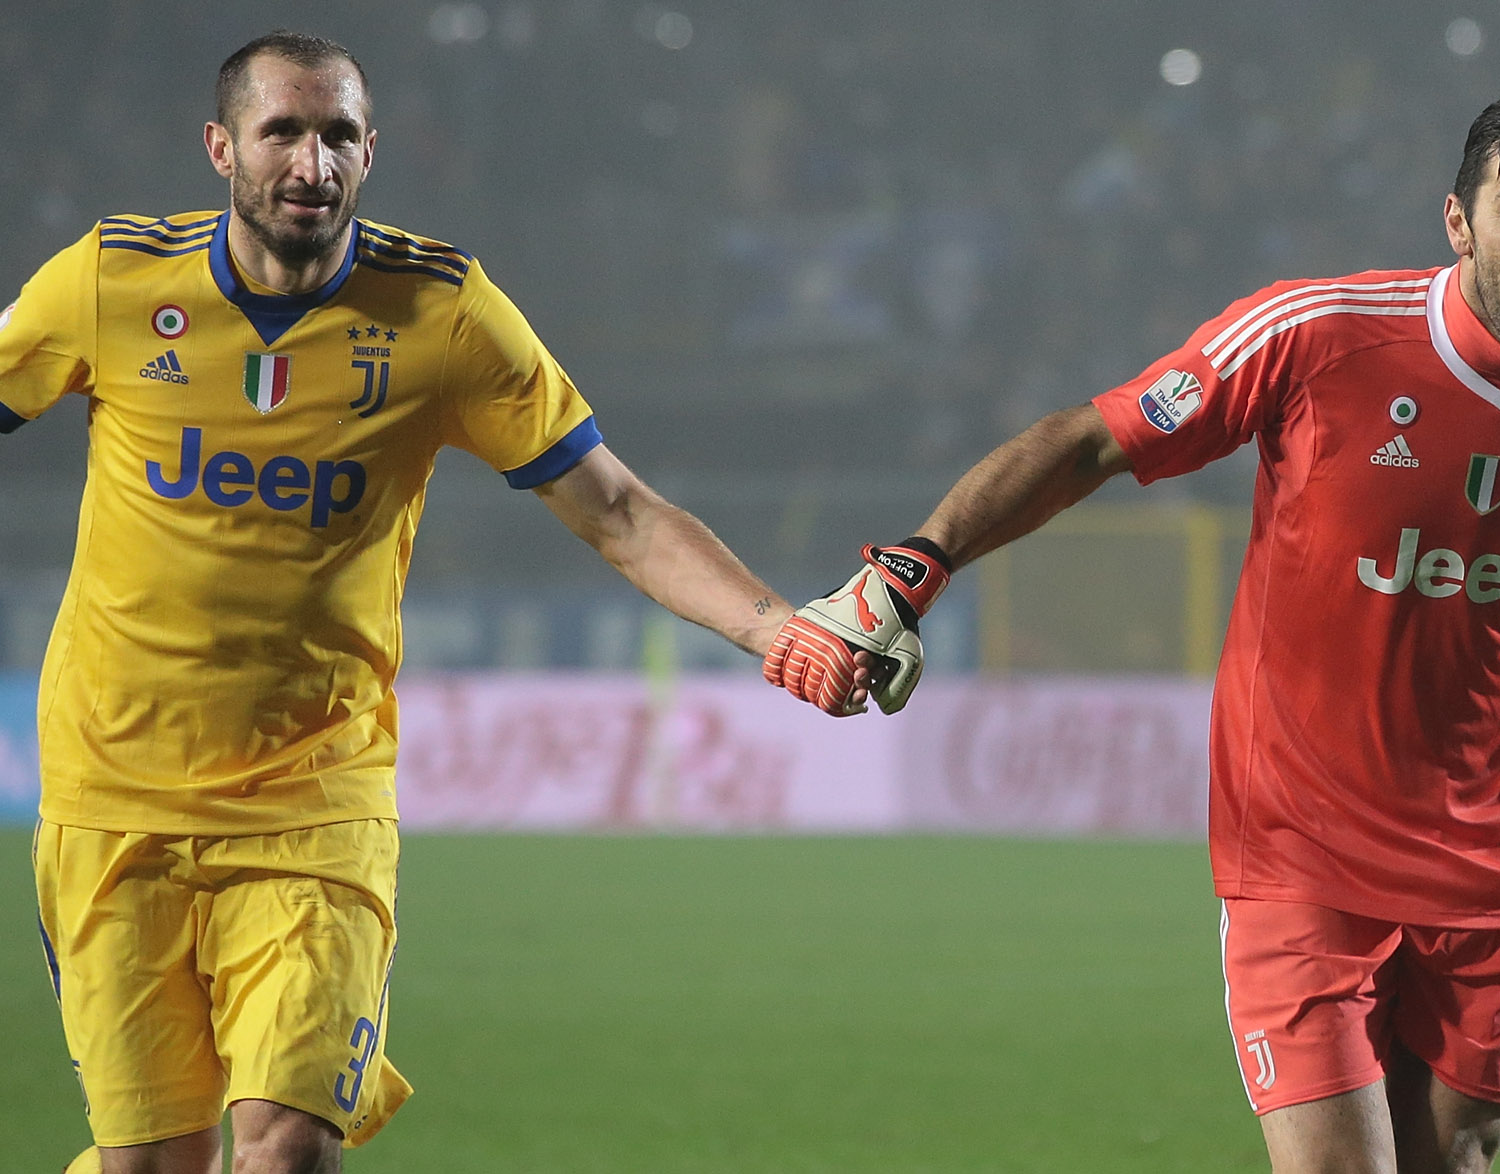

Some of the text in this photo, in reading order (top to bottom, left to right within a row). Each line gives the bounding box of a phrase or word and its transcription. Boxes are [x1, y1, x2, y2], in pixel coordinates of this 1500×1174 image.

[352, 346, 391, 358] JUVENTUS
[139, 367, 189, 385] adidas
[1155, 388, 1182, 418] TIM CUP
[1152, 408, 1170, 428] TIM
[1370, 454, 1420, 468] adidas
[145, 427, 367, 528] Jeep
[877, 553, 915, 579] BUFFON
[333, 1016, 377, 1113] 3
